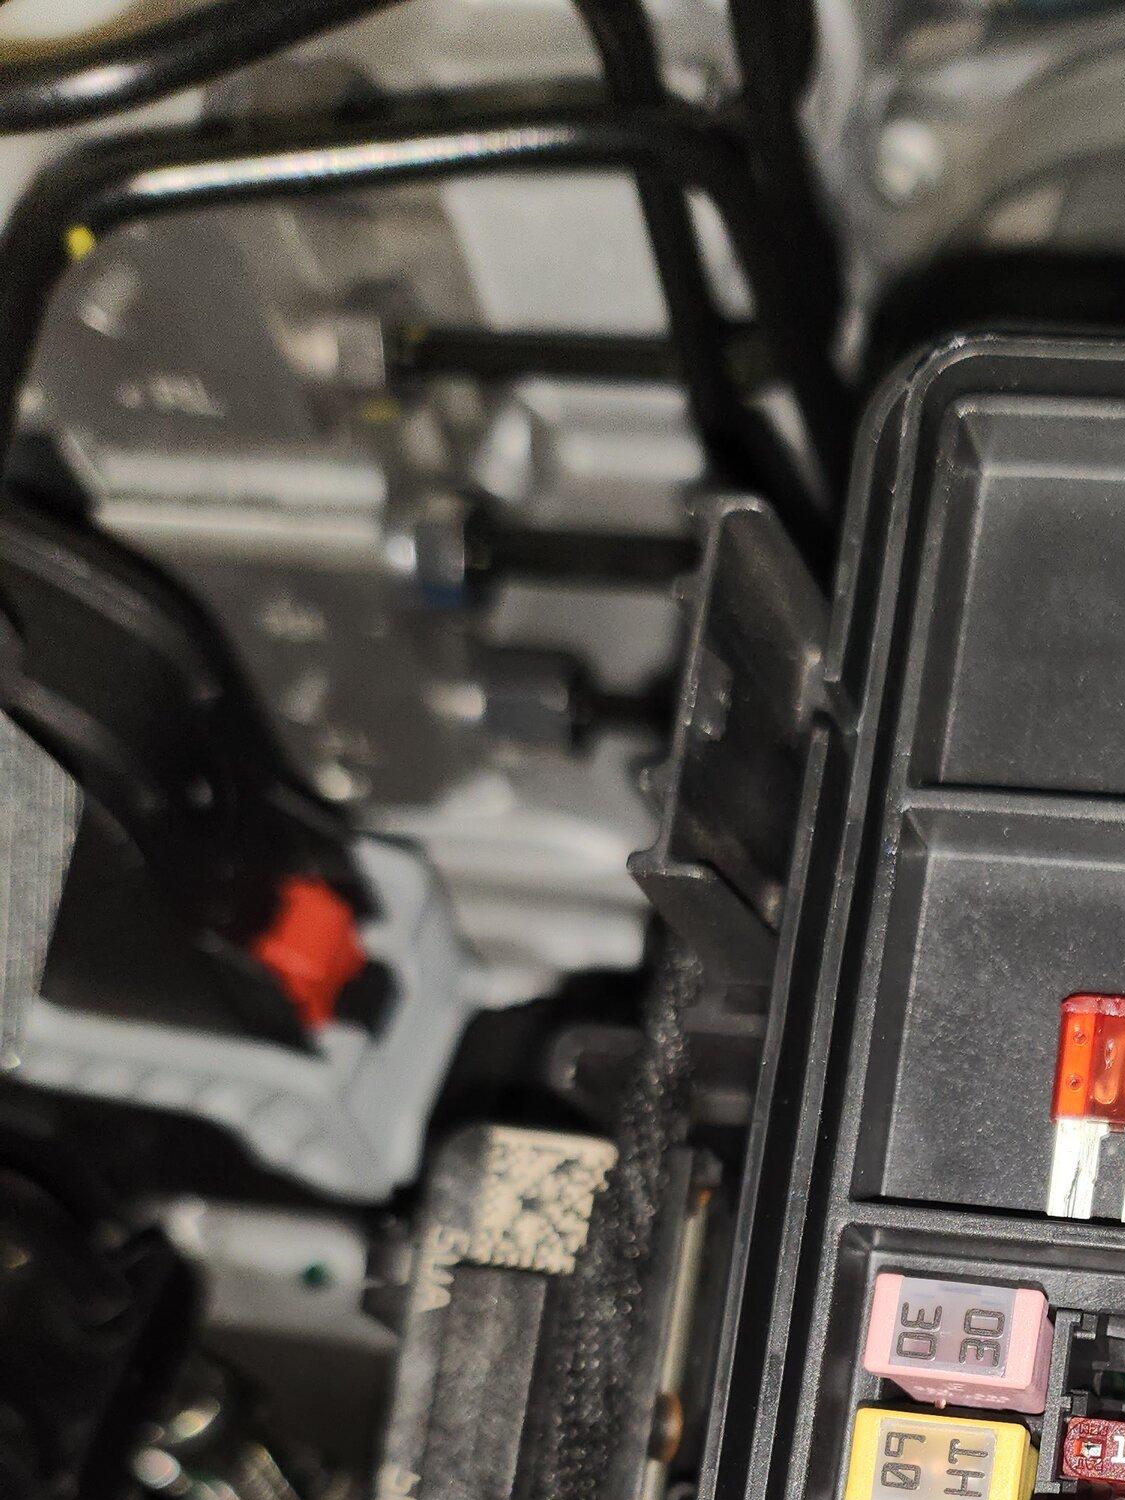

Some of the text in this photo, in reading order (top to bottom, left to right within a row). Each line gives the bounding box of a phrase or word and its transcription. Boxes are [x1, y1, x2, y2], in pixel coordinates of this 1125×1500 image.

[896, 1302, 942, 1360] 30
[959, 1308, 1005, 1367] 30
[881, 1432, 926, 1490] 60
[944, 1438, 989, 1497] HT
